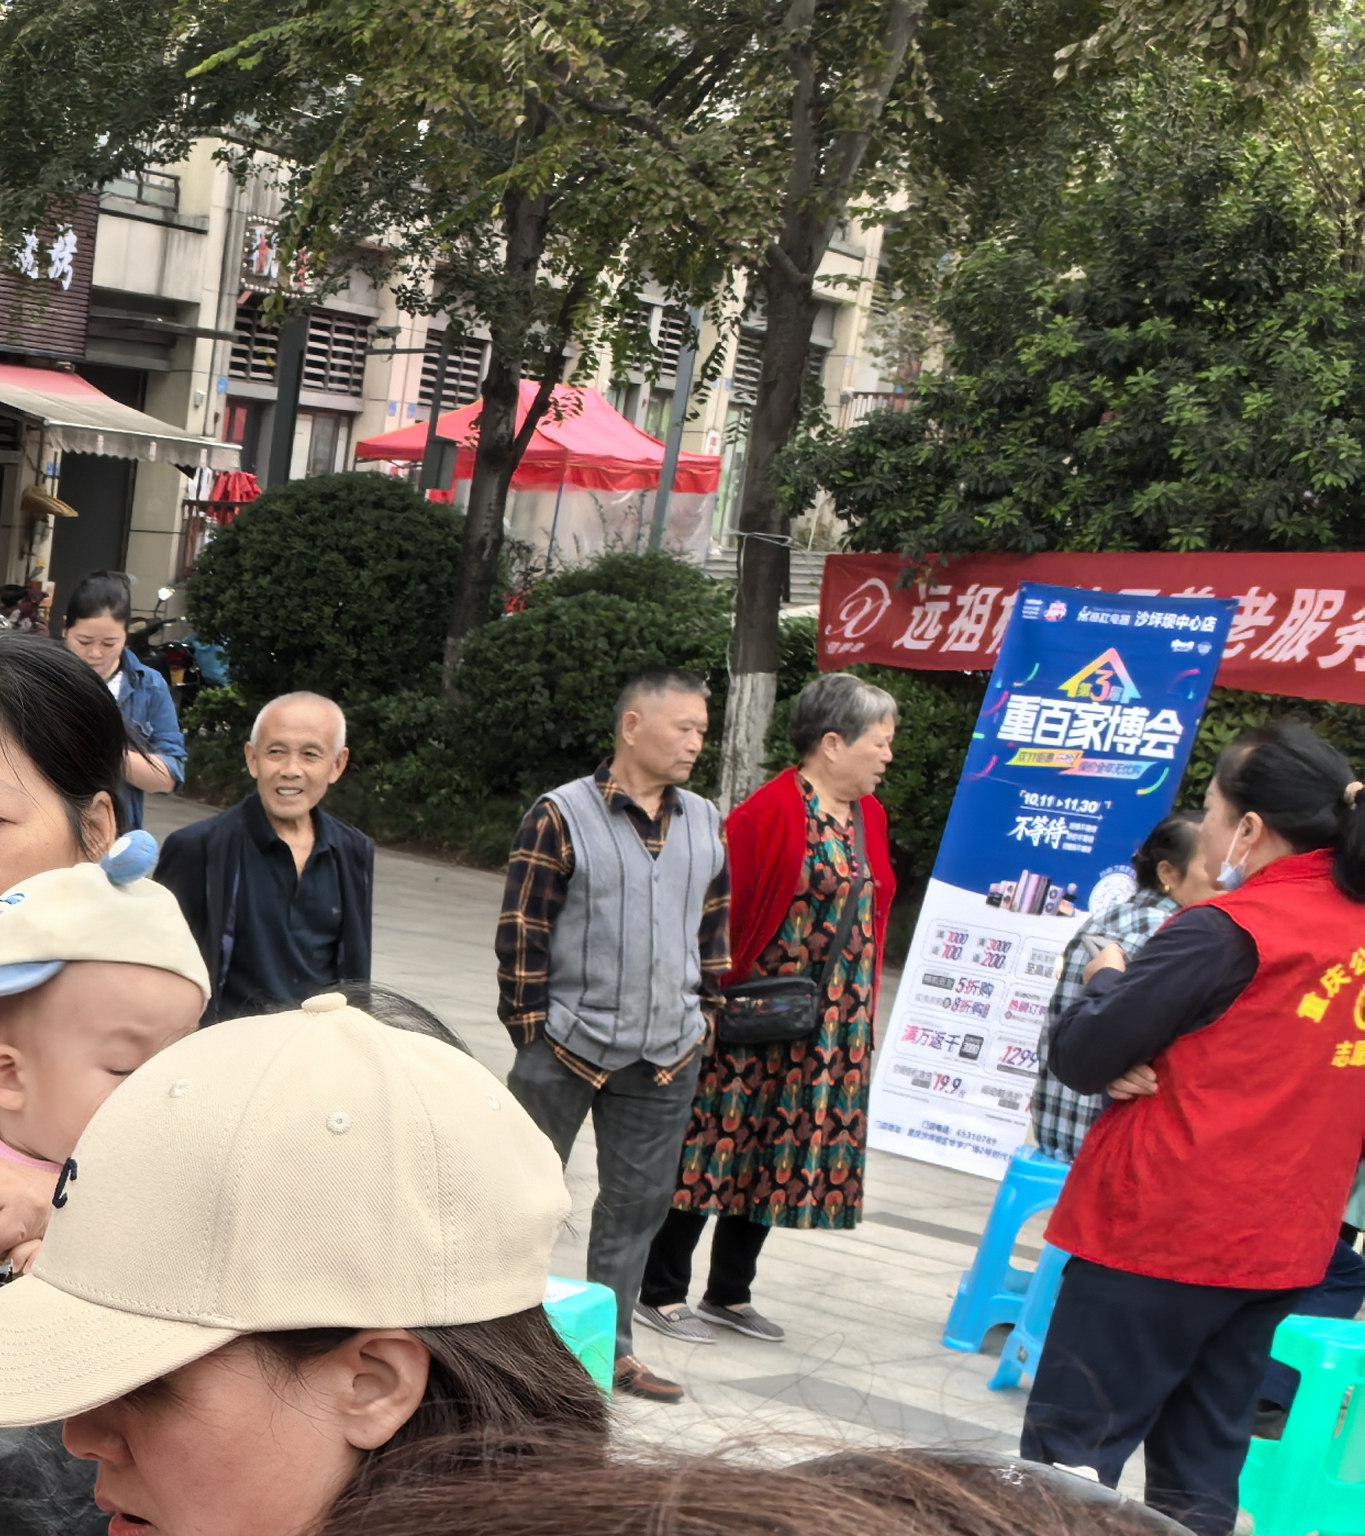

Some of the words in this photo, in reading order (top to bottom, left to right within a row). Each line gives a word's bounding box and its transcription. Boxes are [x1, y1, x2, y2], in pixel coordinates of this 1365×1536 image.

[996, 694, 1184, 760] 重百家博会
